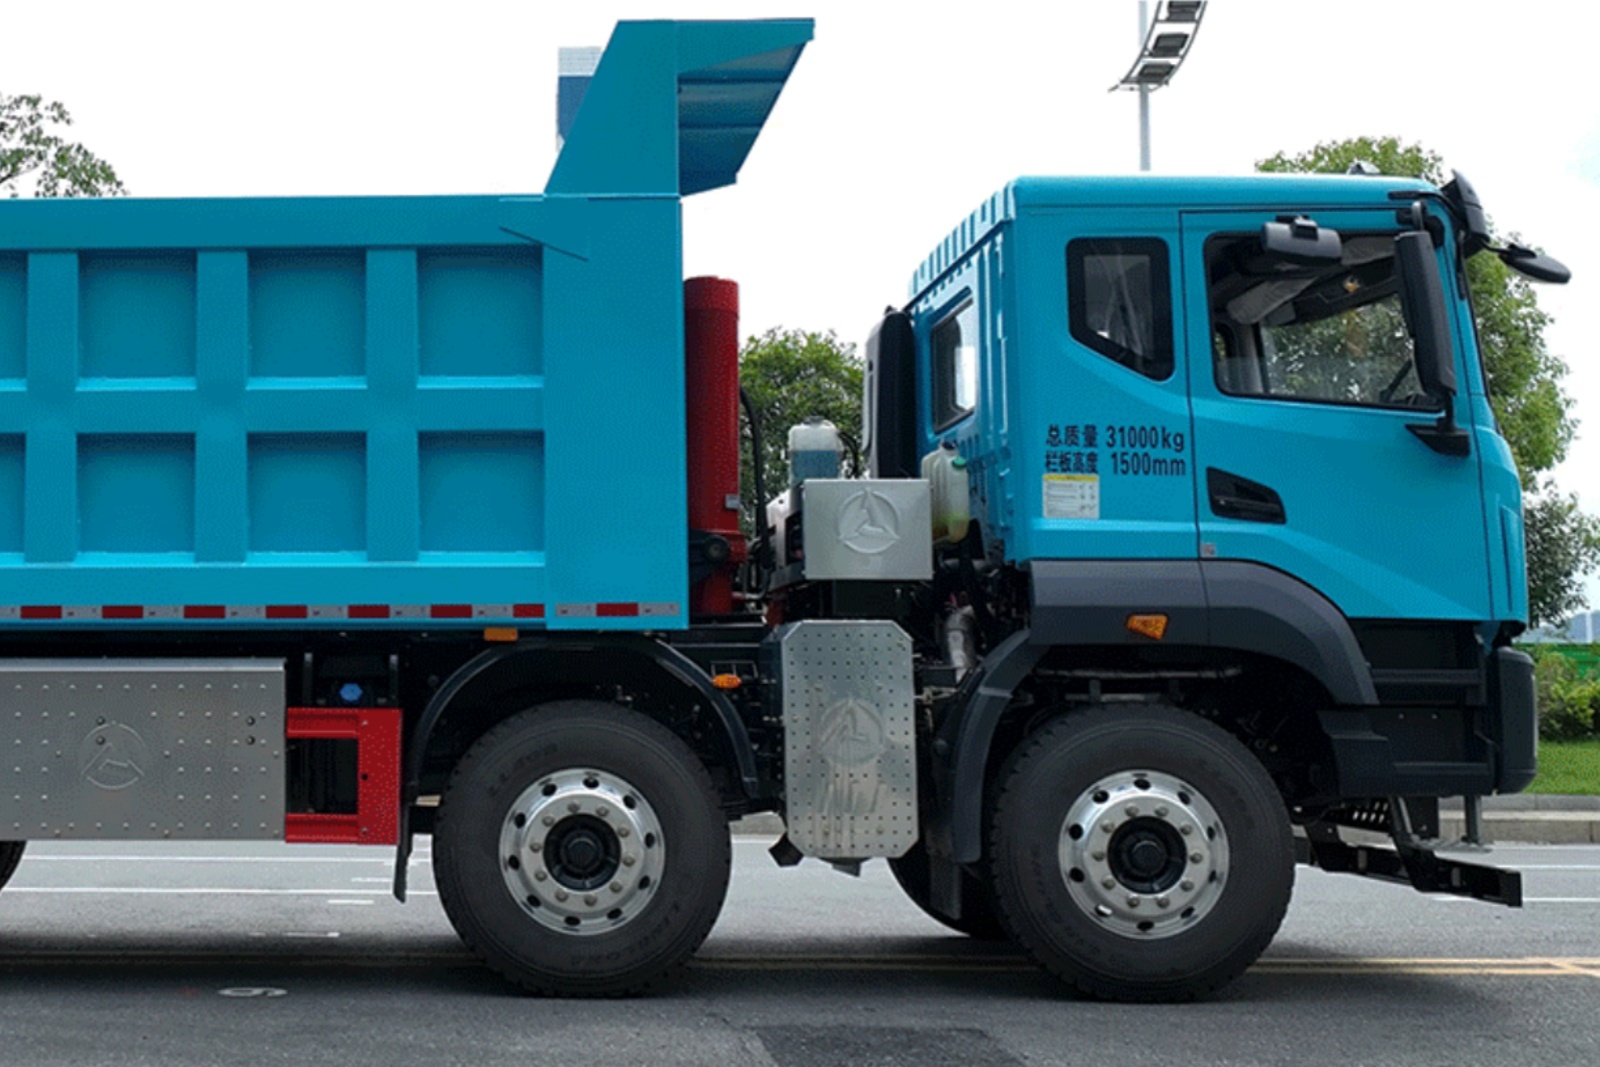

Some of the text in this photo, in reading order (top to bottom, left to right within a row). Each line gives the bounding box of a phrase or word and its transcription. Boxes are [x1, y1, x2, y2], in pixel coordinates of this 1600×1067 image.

[1046, 424, 1185, 453] 总质量 31000kg
[1045, 451, 1186, 476] 栏板高度 1500mm
